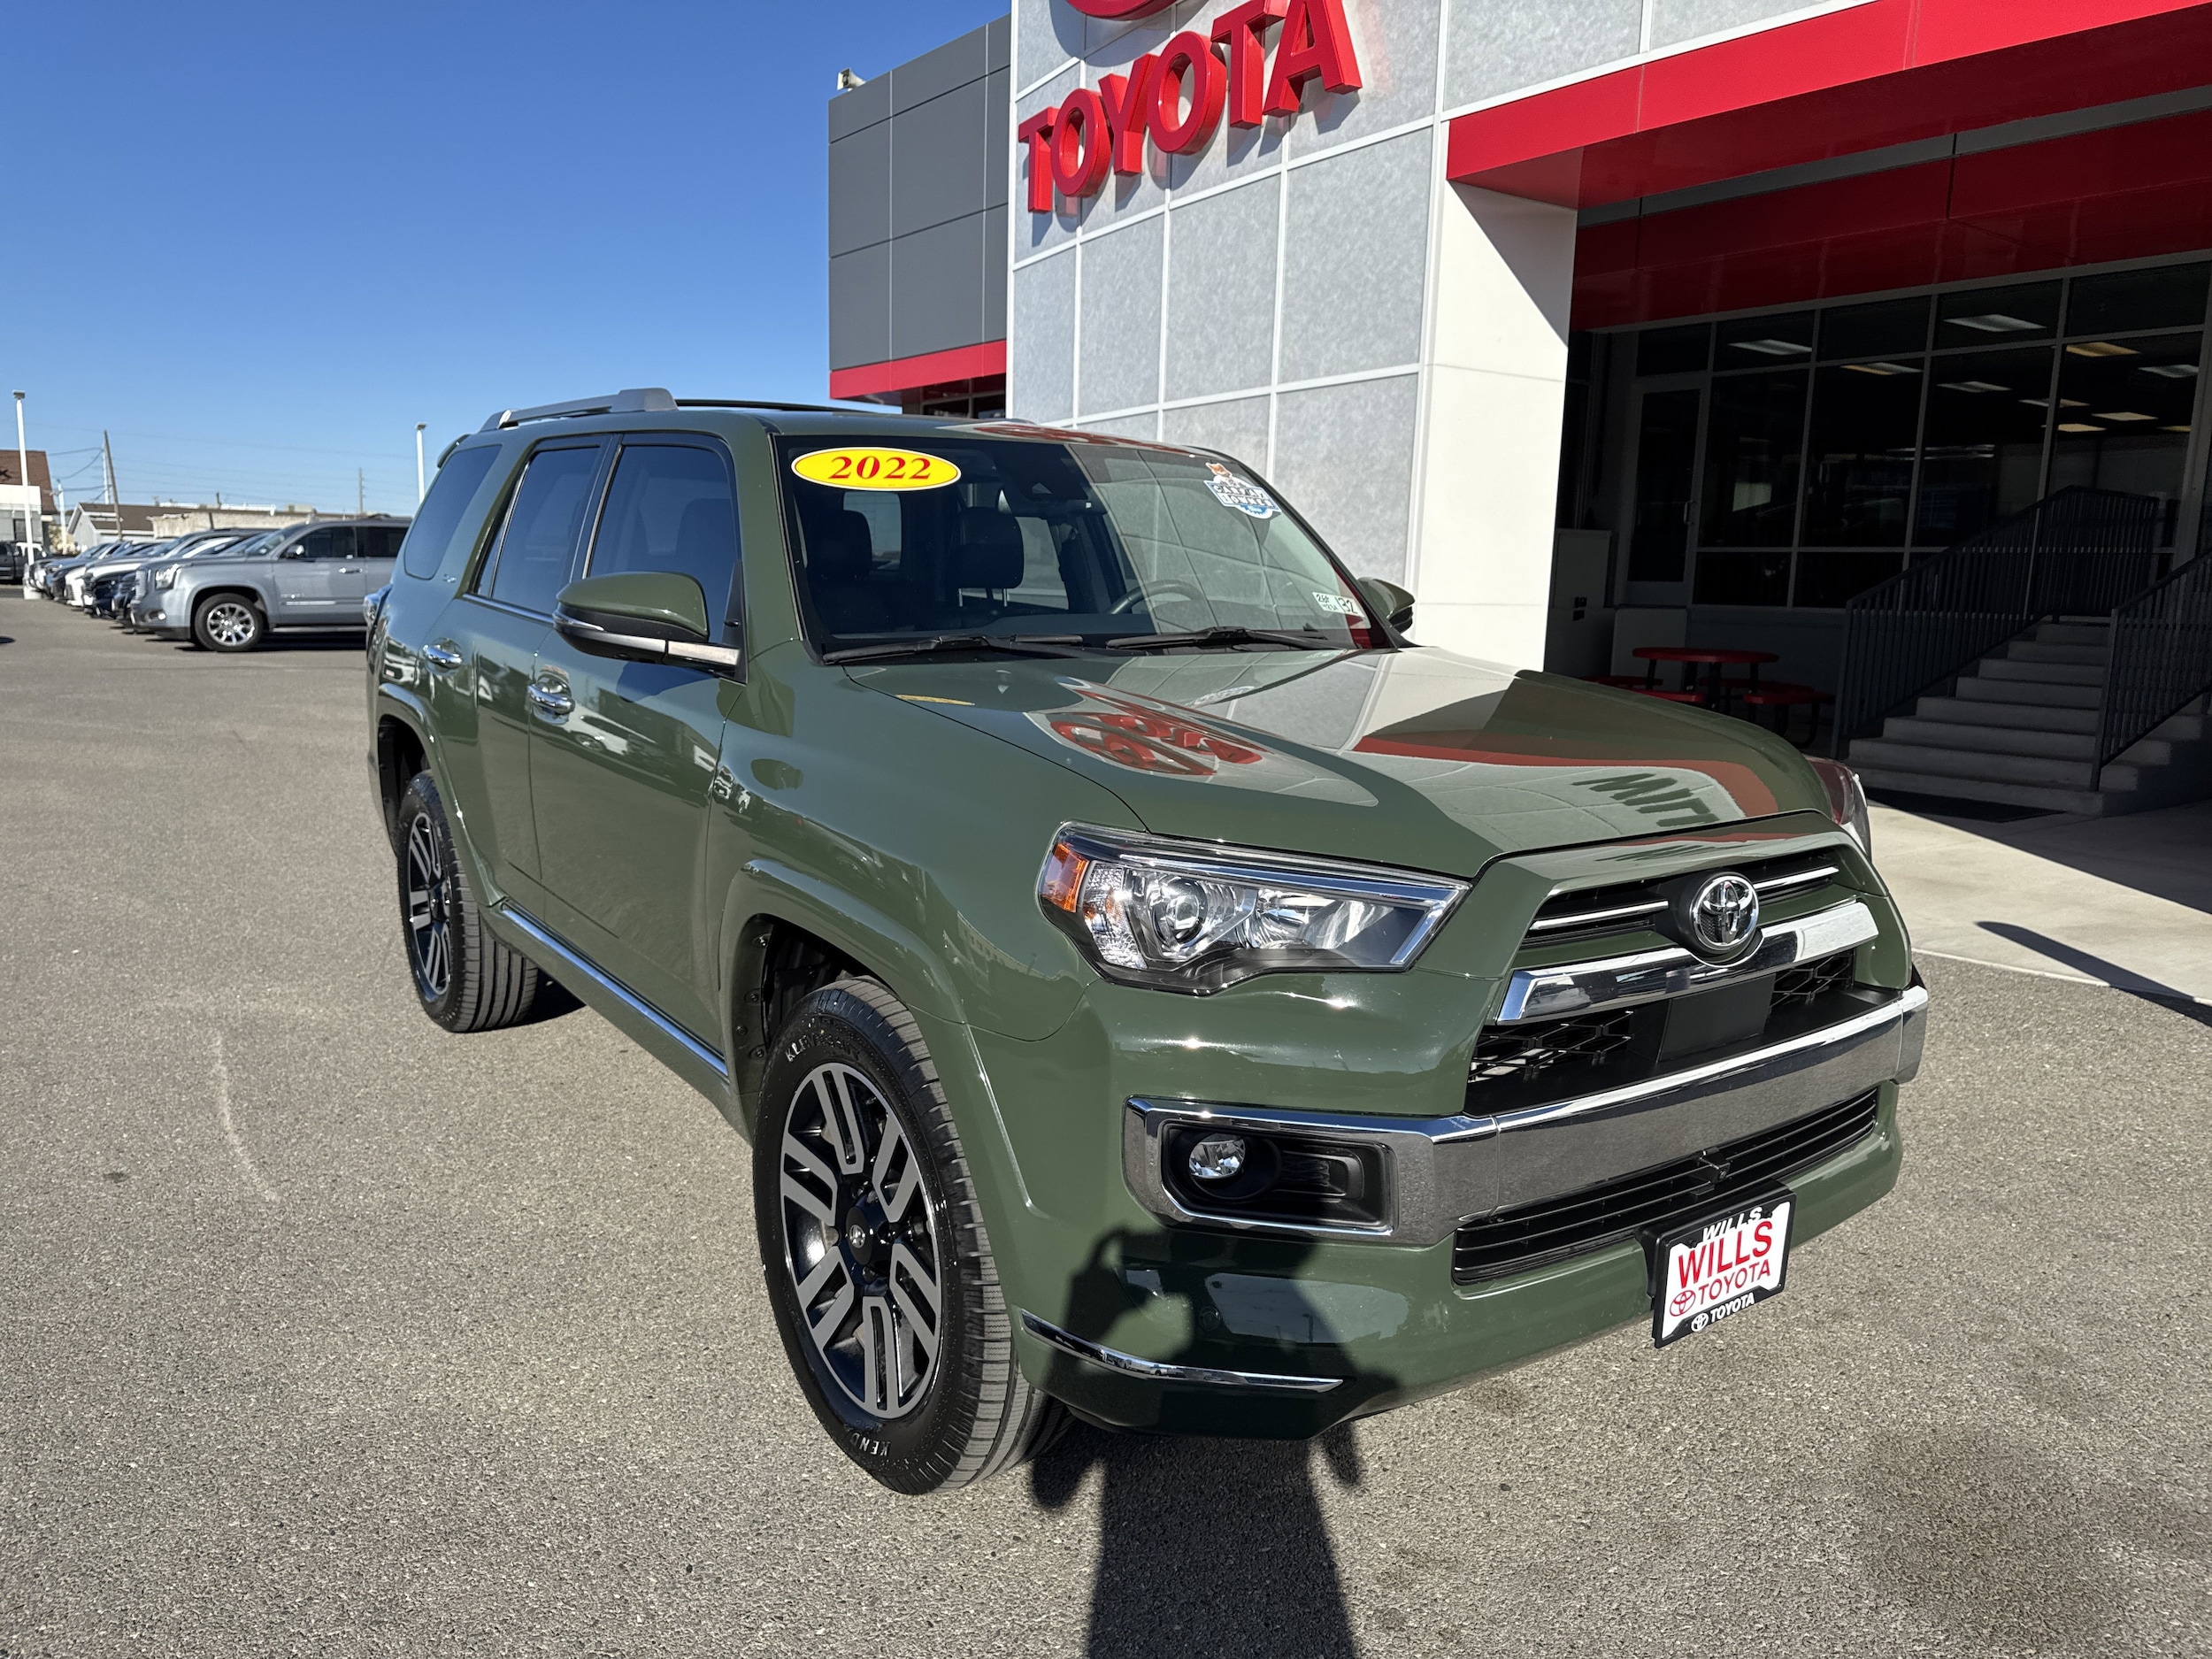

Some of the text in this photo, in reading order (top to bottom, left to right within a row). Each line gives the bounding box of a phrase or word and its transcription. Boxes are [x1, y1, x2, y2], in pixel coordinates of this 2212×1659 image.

[1018, 0, 1363, 213] TOYOTA
[828, 456, 931, 480] 2022
[1702, 1206, 1763, 1242] WILLS
[1678, 1221, 1773, 1288] WILLS
[1699, 1259, 1771, 1305] TOYOTA
[1710, 1292, 1755, 1323] TOYOTA
